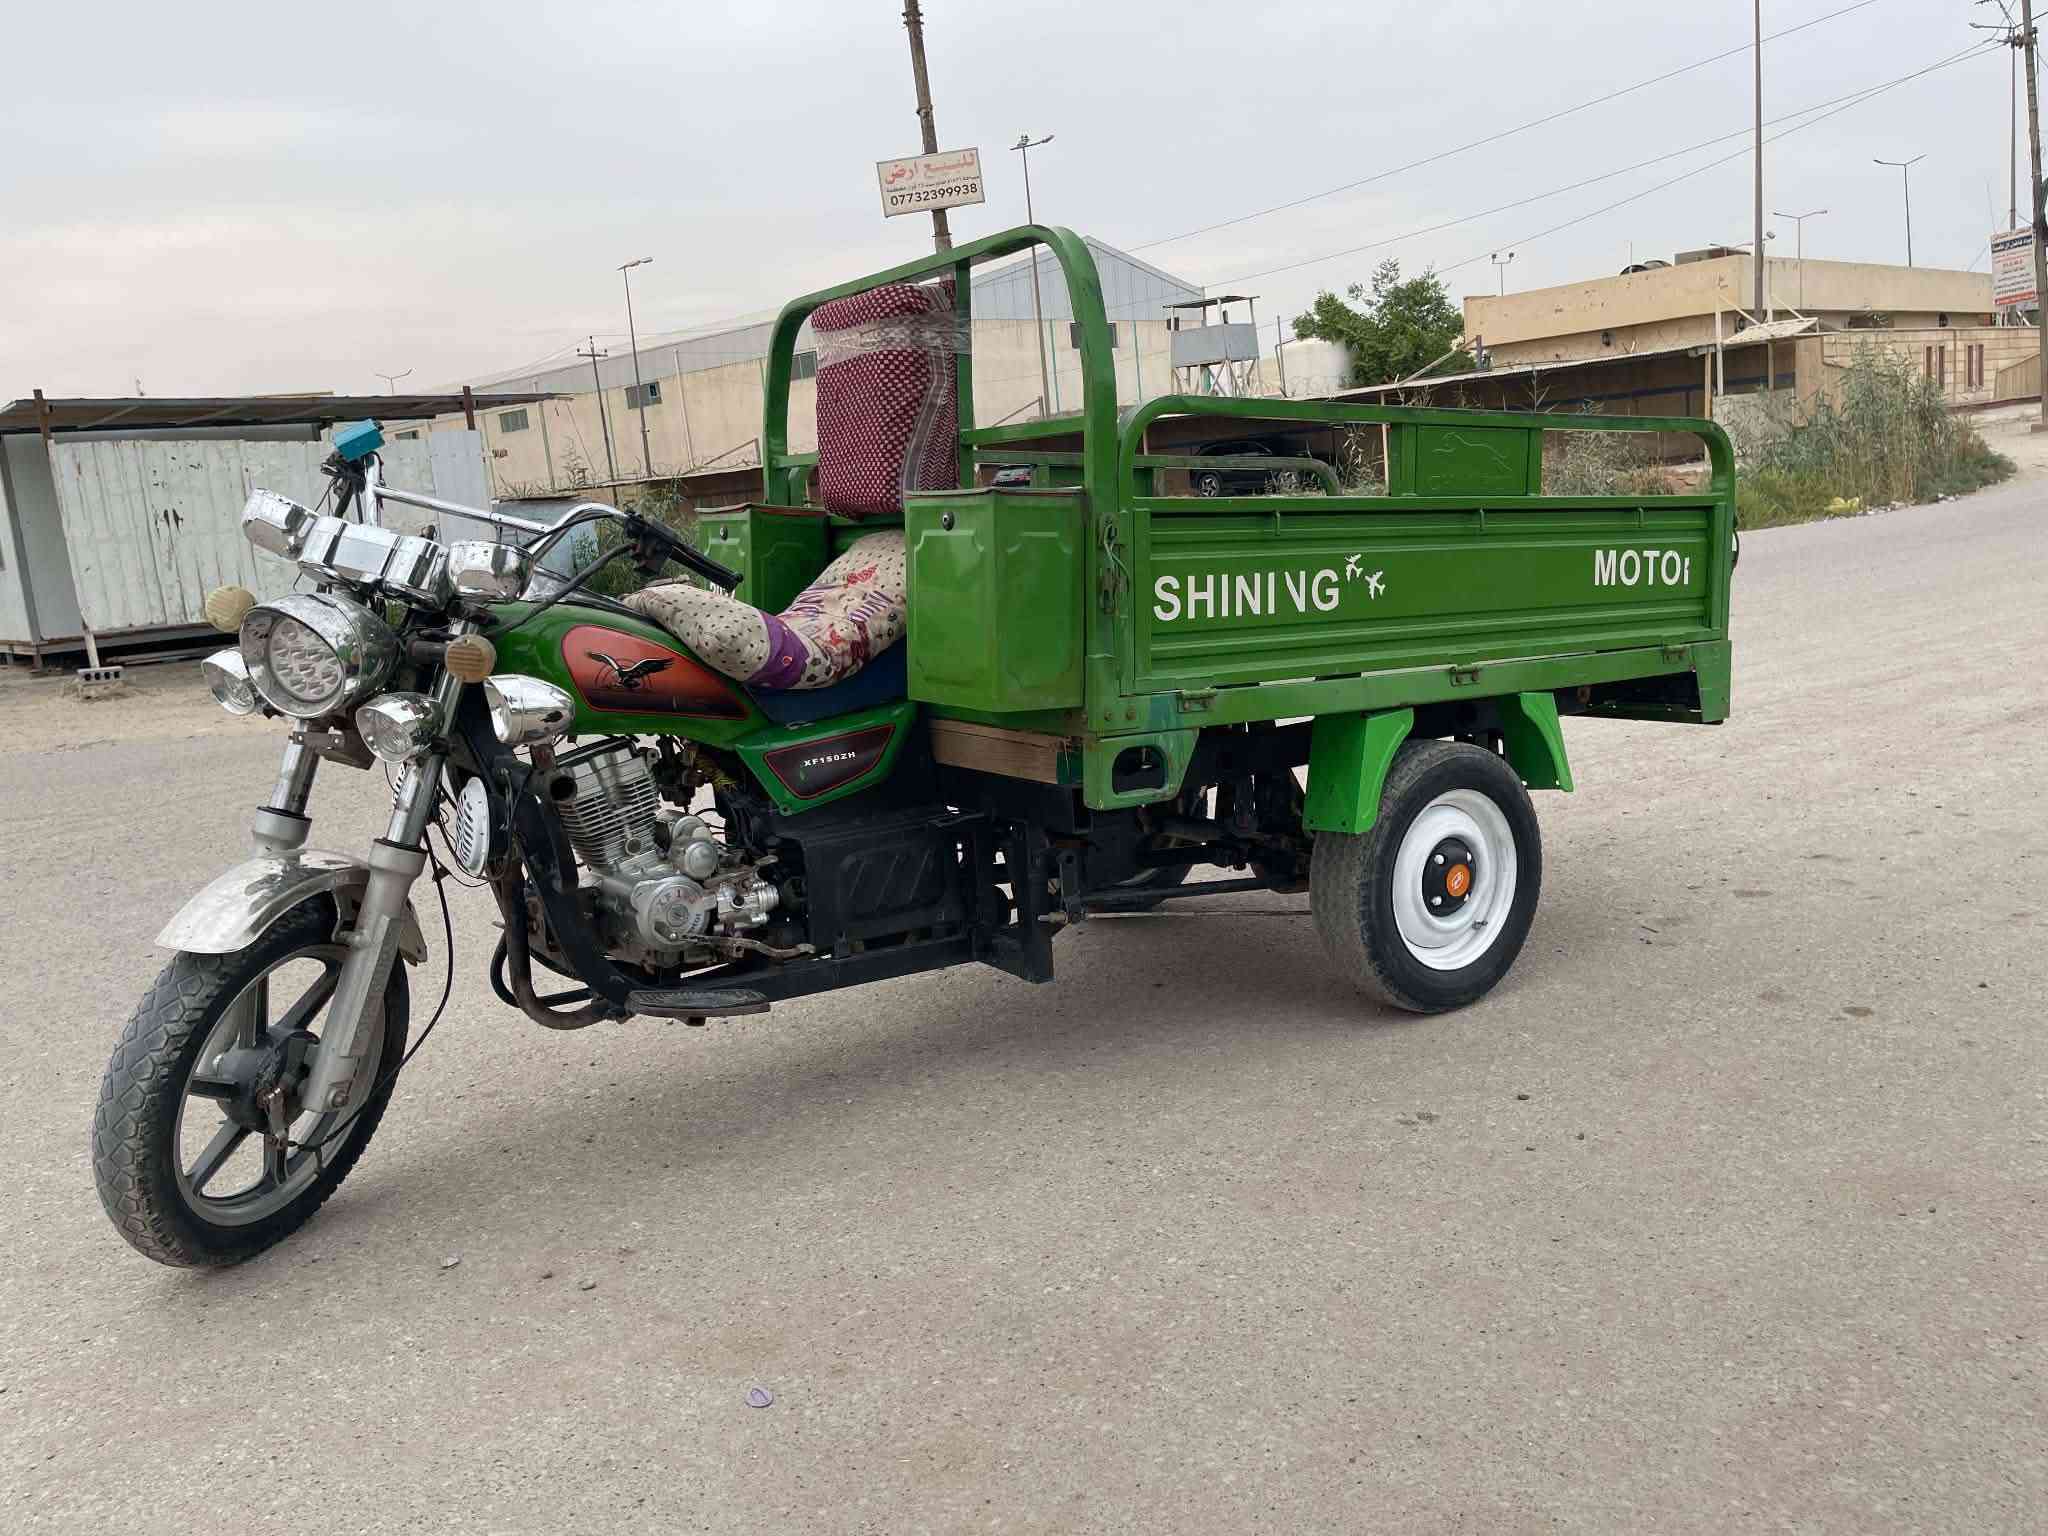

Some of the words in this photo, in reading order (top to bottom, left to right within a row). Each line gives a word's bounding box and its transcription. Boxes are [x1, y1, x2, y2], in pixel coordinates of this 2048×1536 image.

[890, 183, 978, 207] 07732399938
[1153, 568, 1340, 622] SHINING
[803, 751, 857, 767] XF150ZH
